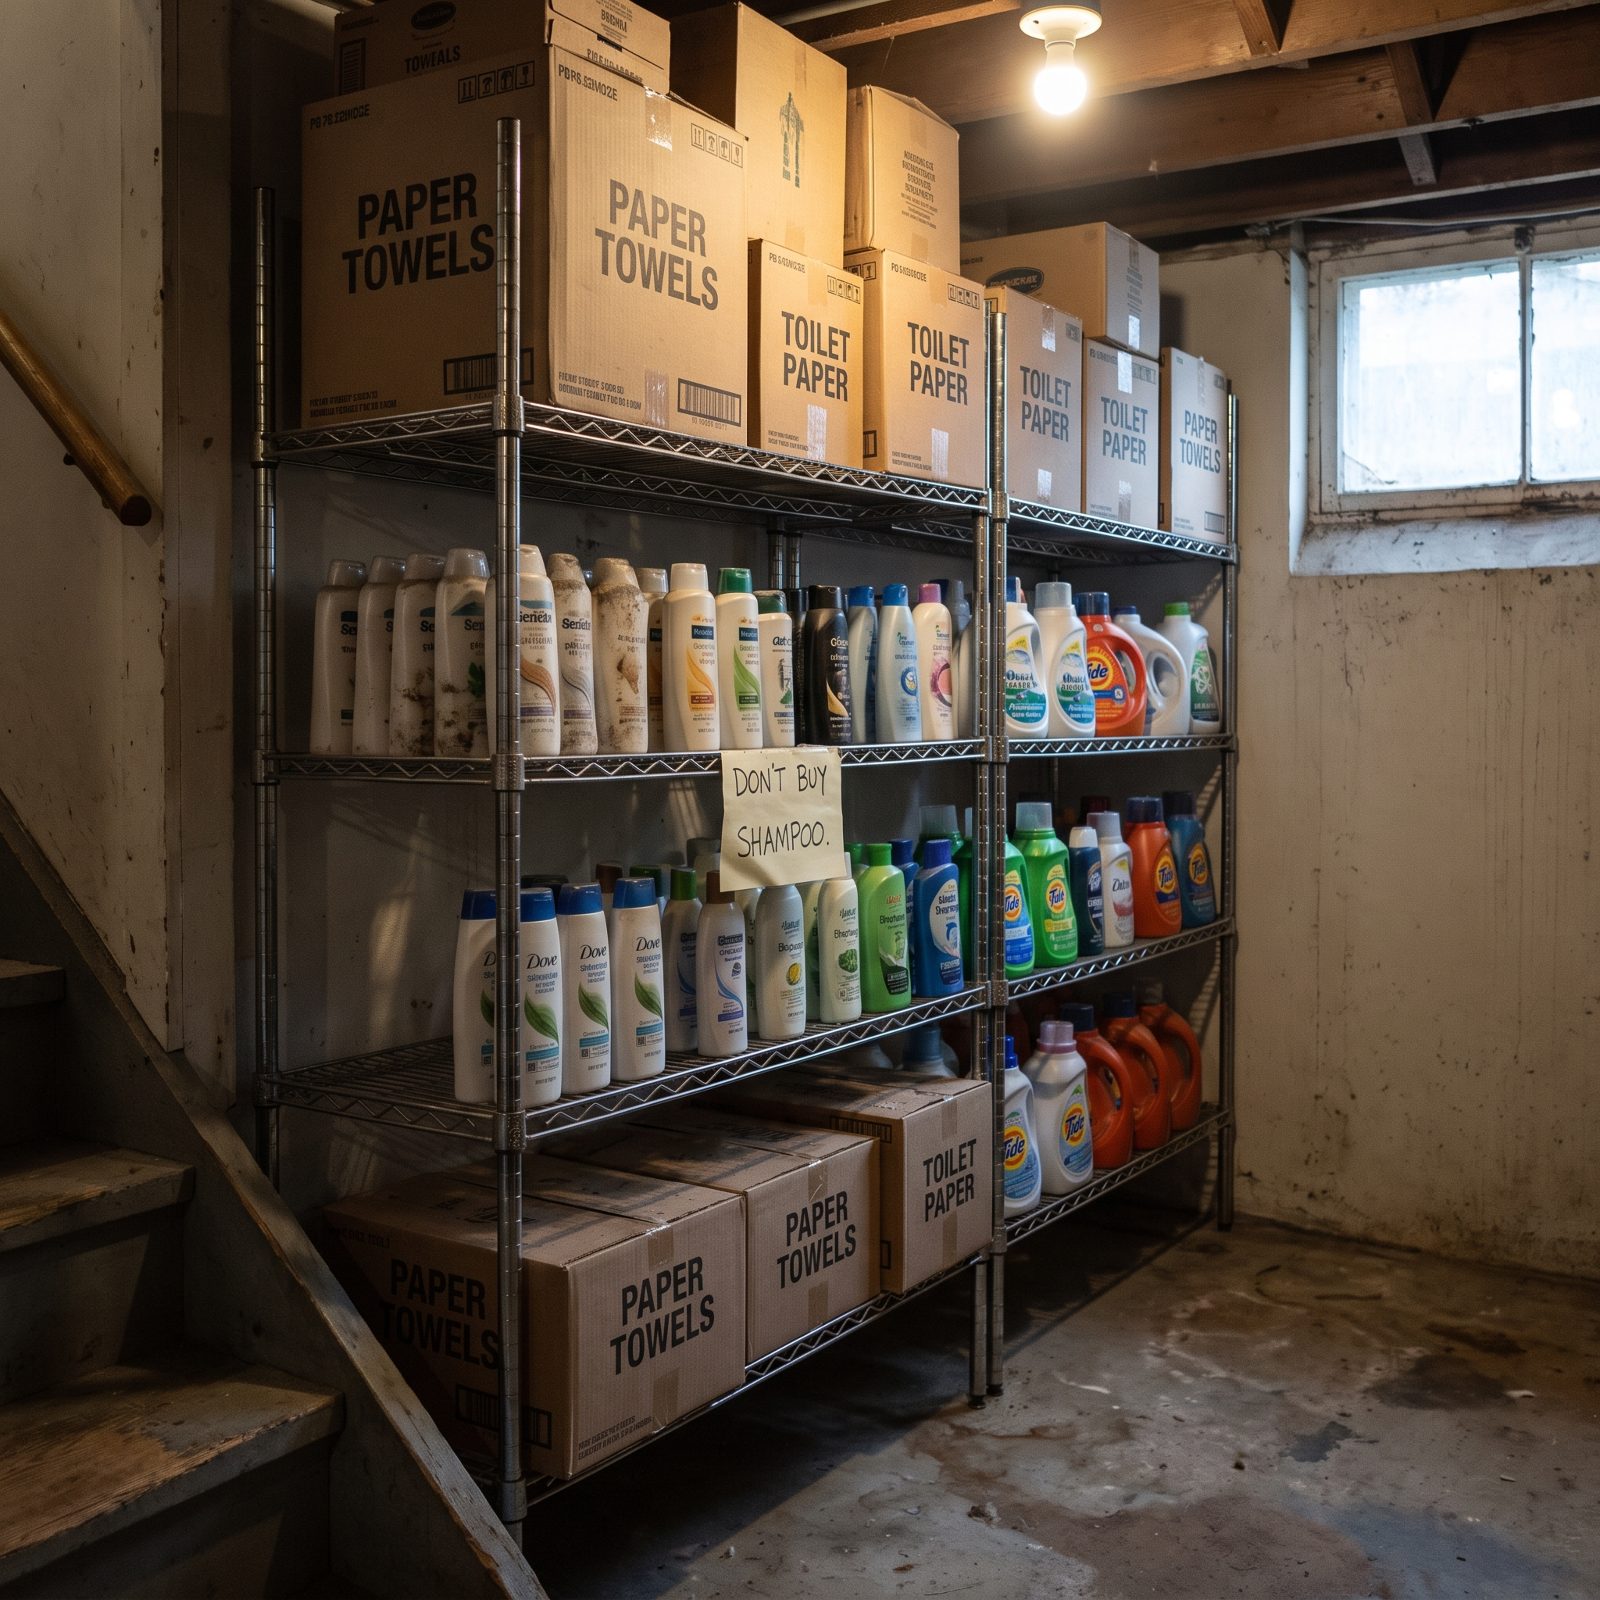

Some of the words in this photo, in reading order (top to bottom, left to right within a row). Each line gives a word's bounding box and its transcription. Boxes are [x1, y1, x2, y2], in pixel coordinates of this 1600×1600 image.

[358, 172, 478, 240] PAPER
[609, 178, 706, 257] PAPER
[342, 224, 495, 294] TOWELS
[595, 228, 719, 310] TOWELS
[781, 311, 850, 363] TOILET
[907, 322, 970, 369] TOILET
[784, 352, 848, 402] PAPER
[910, 360, 968, 406] PAPER
[1020, 365, 1071, 409] TOILET
[1021, 400, 1069, 443] PAPER
[1101, 396, 1148, 435] TOILET
[1184, 409, 1218, 445] PAPER
[1102, 429, 1147, 466] PAPER
[1179, 438, 1221, 474] TOWELS
[733, 762, 786, 797] DON'T
[797, 764, 827, 796] BUY
[737, 821, 830, 858] SHAMPOO.
[526, 953, 558, 969] Dove
[580, 944, 607, 960] Dove
[636, 936, 660, 952] Dove
[923, 1138, 977, 1187] TOILET
[786, 1190, 848, 1247] PAPER
[925, 1173, 975, 1222] PAPER
[777, 1224, 857, 1289] TOWELS
[390, 1258, 486, 1321] PAPER
[622, 1256, 704, 1327] PAPER
[379, 1300, 499, 1371] TOWELS
[610, 1294, 715, 1375] TOWELS
